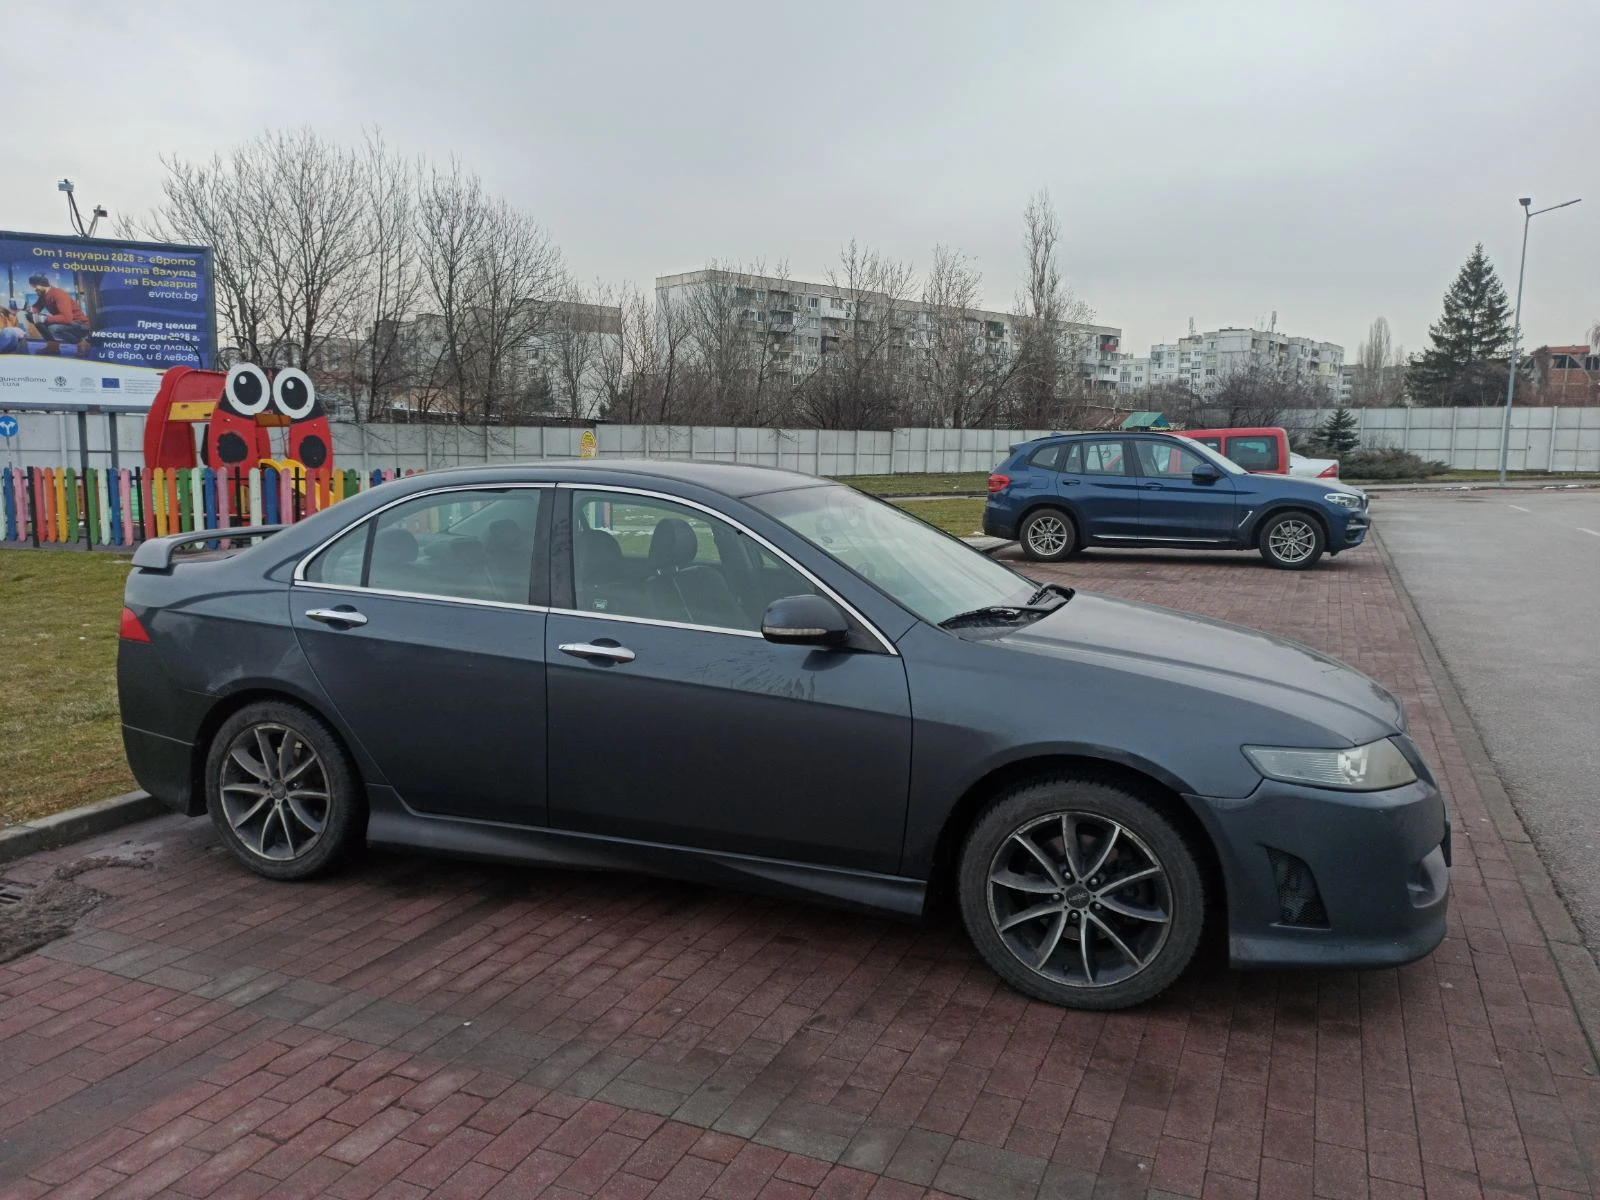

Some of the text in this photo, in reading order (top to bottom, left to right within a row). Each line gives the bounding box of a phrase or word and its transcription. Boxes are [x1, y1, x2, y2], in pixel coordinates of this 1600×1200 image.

[32, 248, 55, 256] От
[58, 250, 62, 258] 1
[65, 251, 109, 261] януари
[149, 256, 196, 266] еврото
[64, 262, 150, 275] официалната
[152, 266, 196, 278] валута
[142, 278, 196, 288] България
[148, 291, 198, 301] evroto.bg
[138, 320, 163, 330] През
[128, 333, 167, 342] януари
[104, 340, 132, 349] може
[117, 352, 144, 360] евро,
